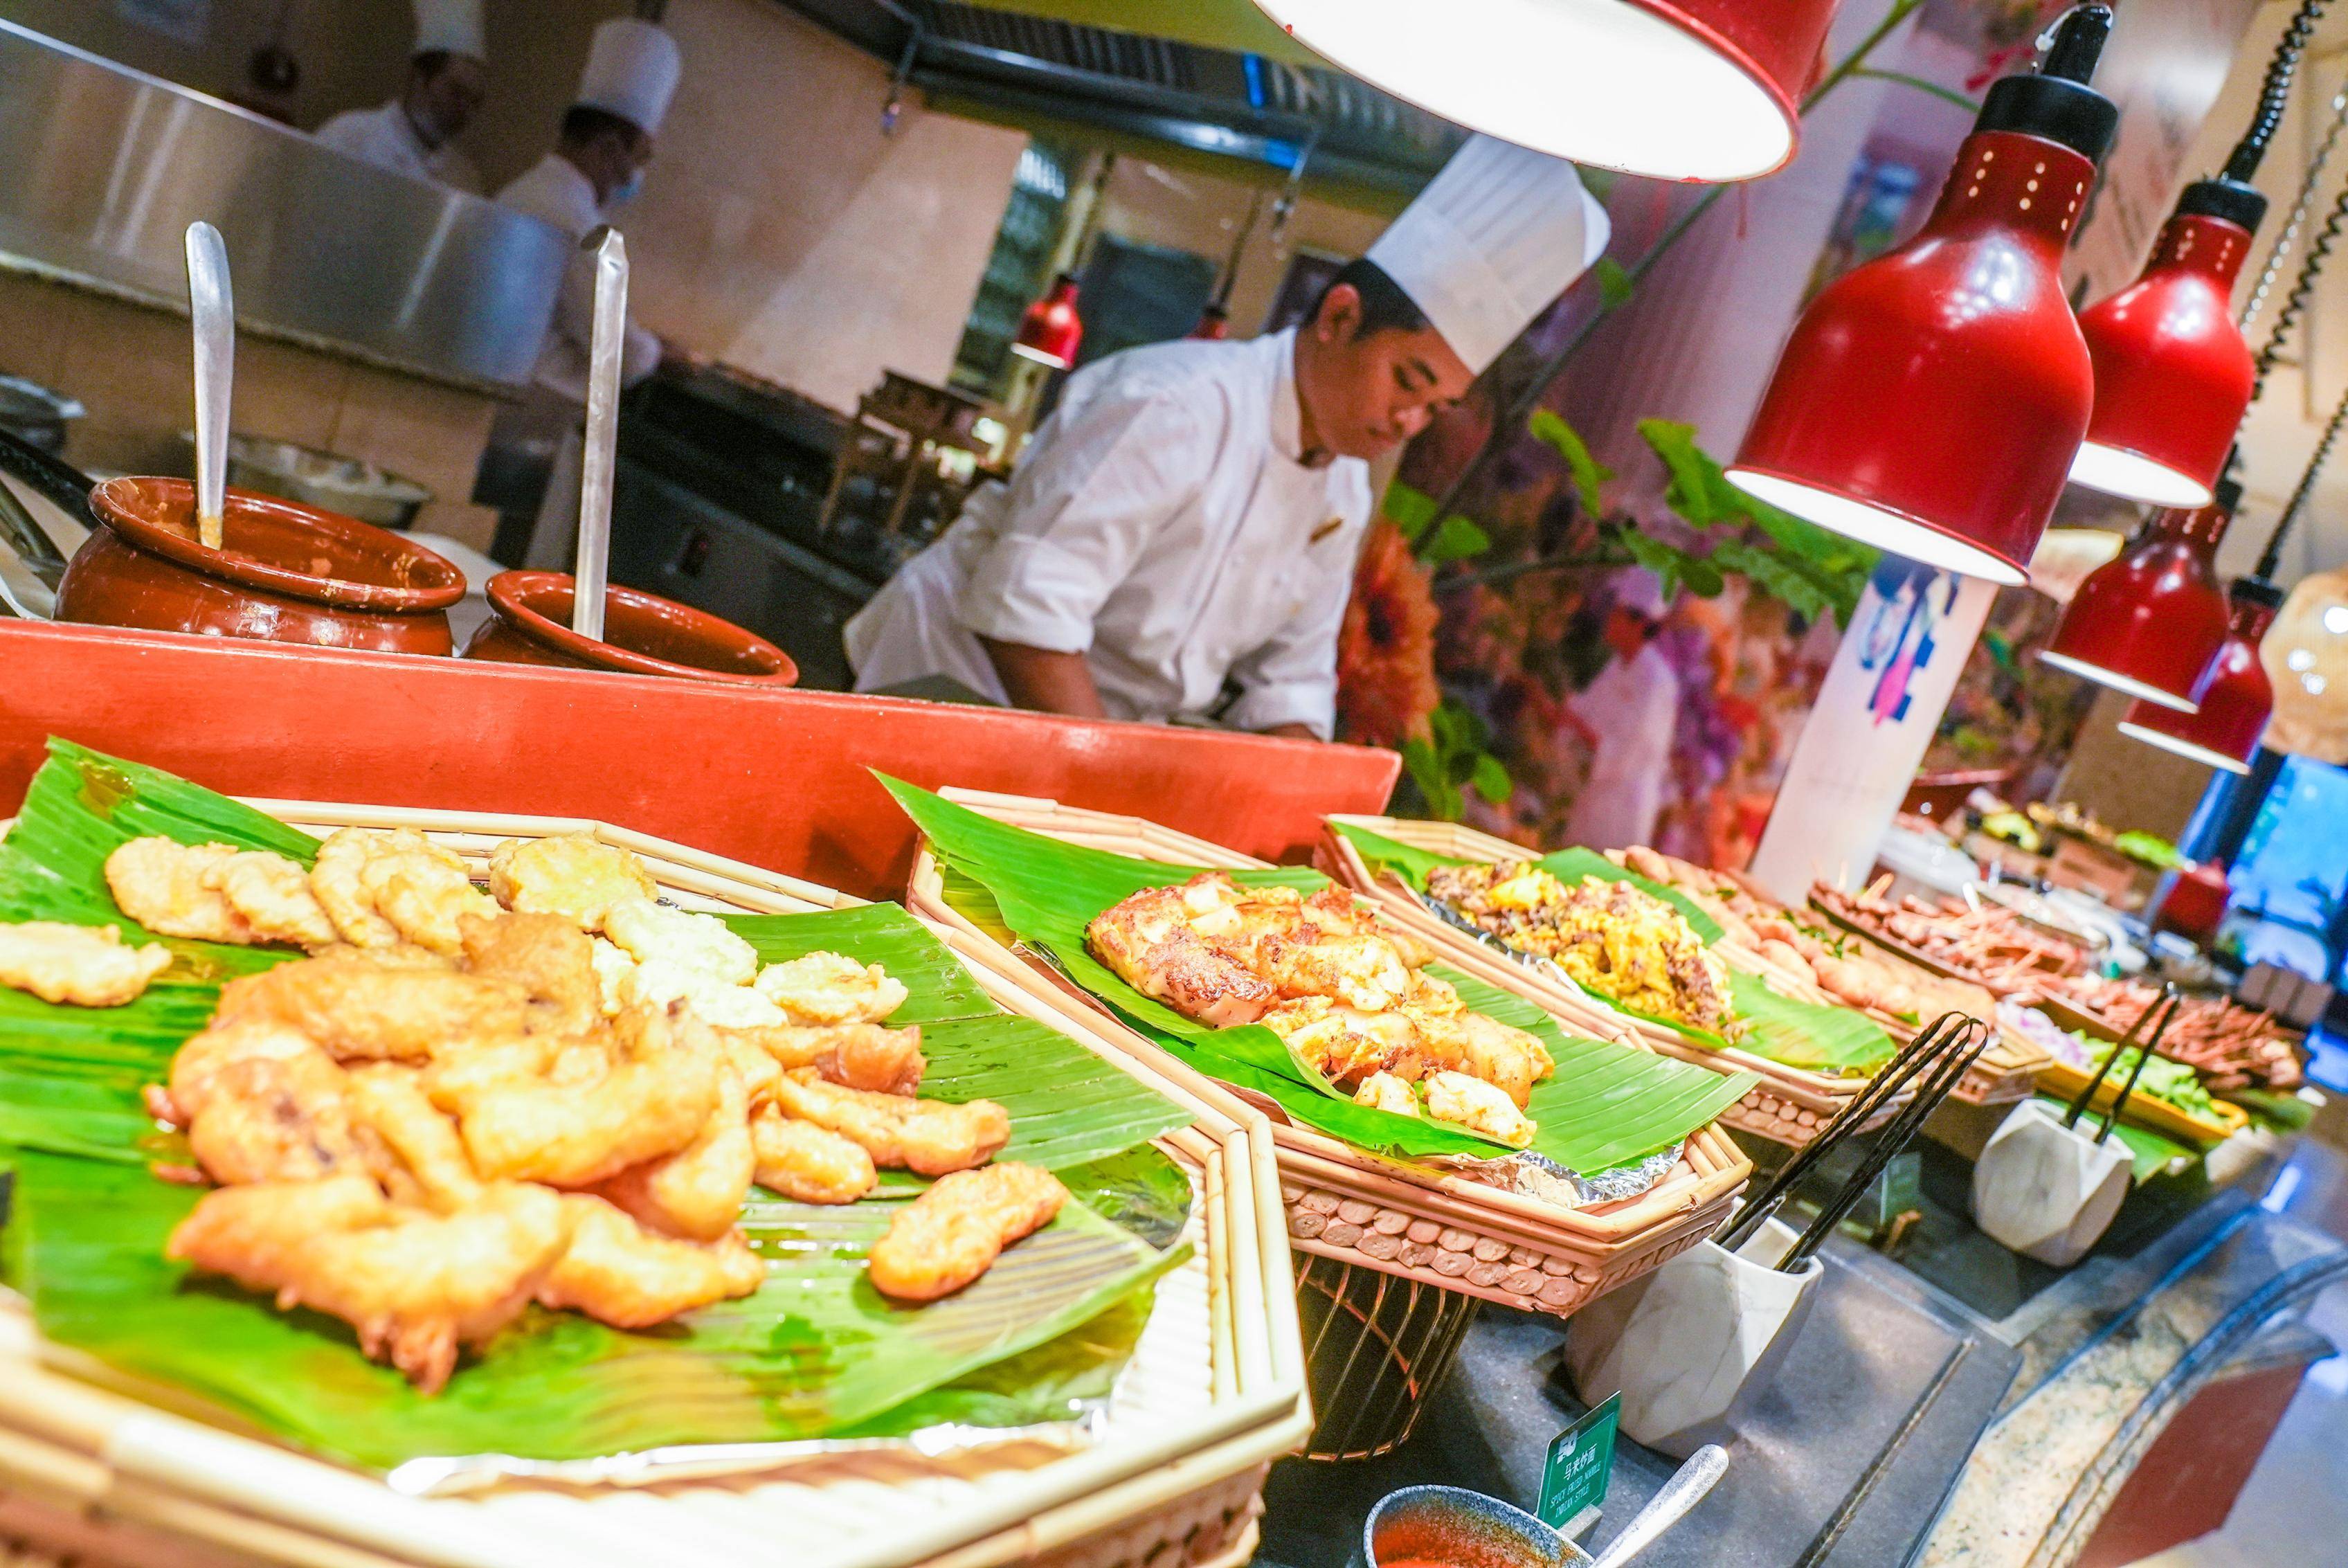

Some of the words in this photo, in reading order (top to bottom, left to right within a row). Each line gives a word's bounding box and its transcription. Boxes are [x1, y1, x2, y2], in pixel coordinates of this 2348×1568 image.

[1563, 1443, 1598, 1481] 马来炒面
[1567, 1475, 1584, 1495] FRIED
[1574, 1482, 1590, 1503] STYLE
